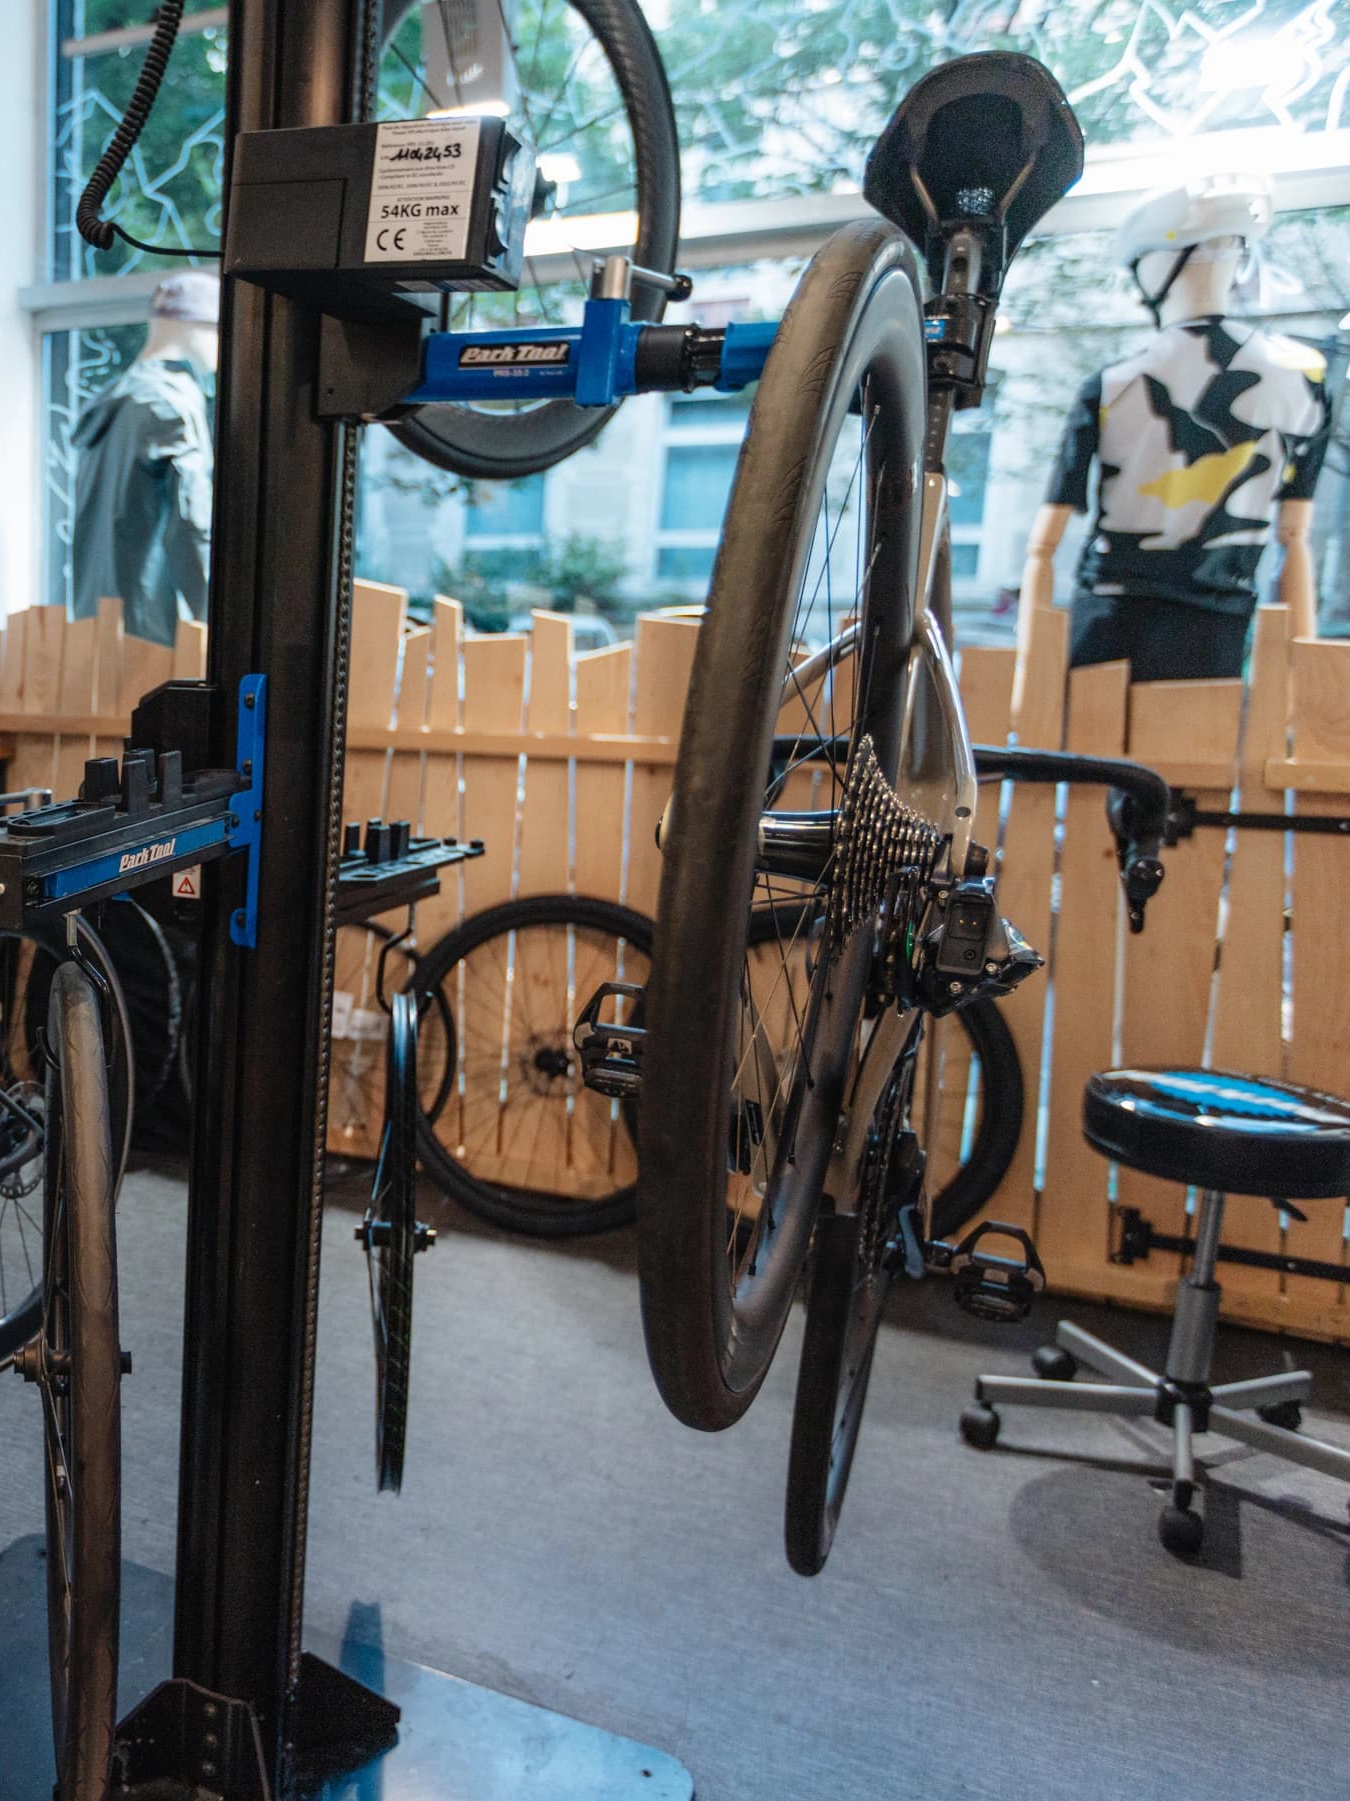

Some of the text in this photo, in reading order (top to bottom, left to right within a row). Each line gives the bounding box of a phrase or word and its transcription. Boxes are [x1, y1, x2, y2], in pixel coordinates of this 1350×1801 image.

[381, 203, 459, 219] 54KG max
[376, 228, 407, 252] CE
[460, 343, 569, 363] Park Tool
[119, 838, 176, 873] Park Tool
